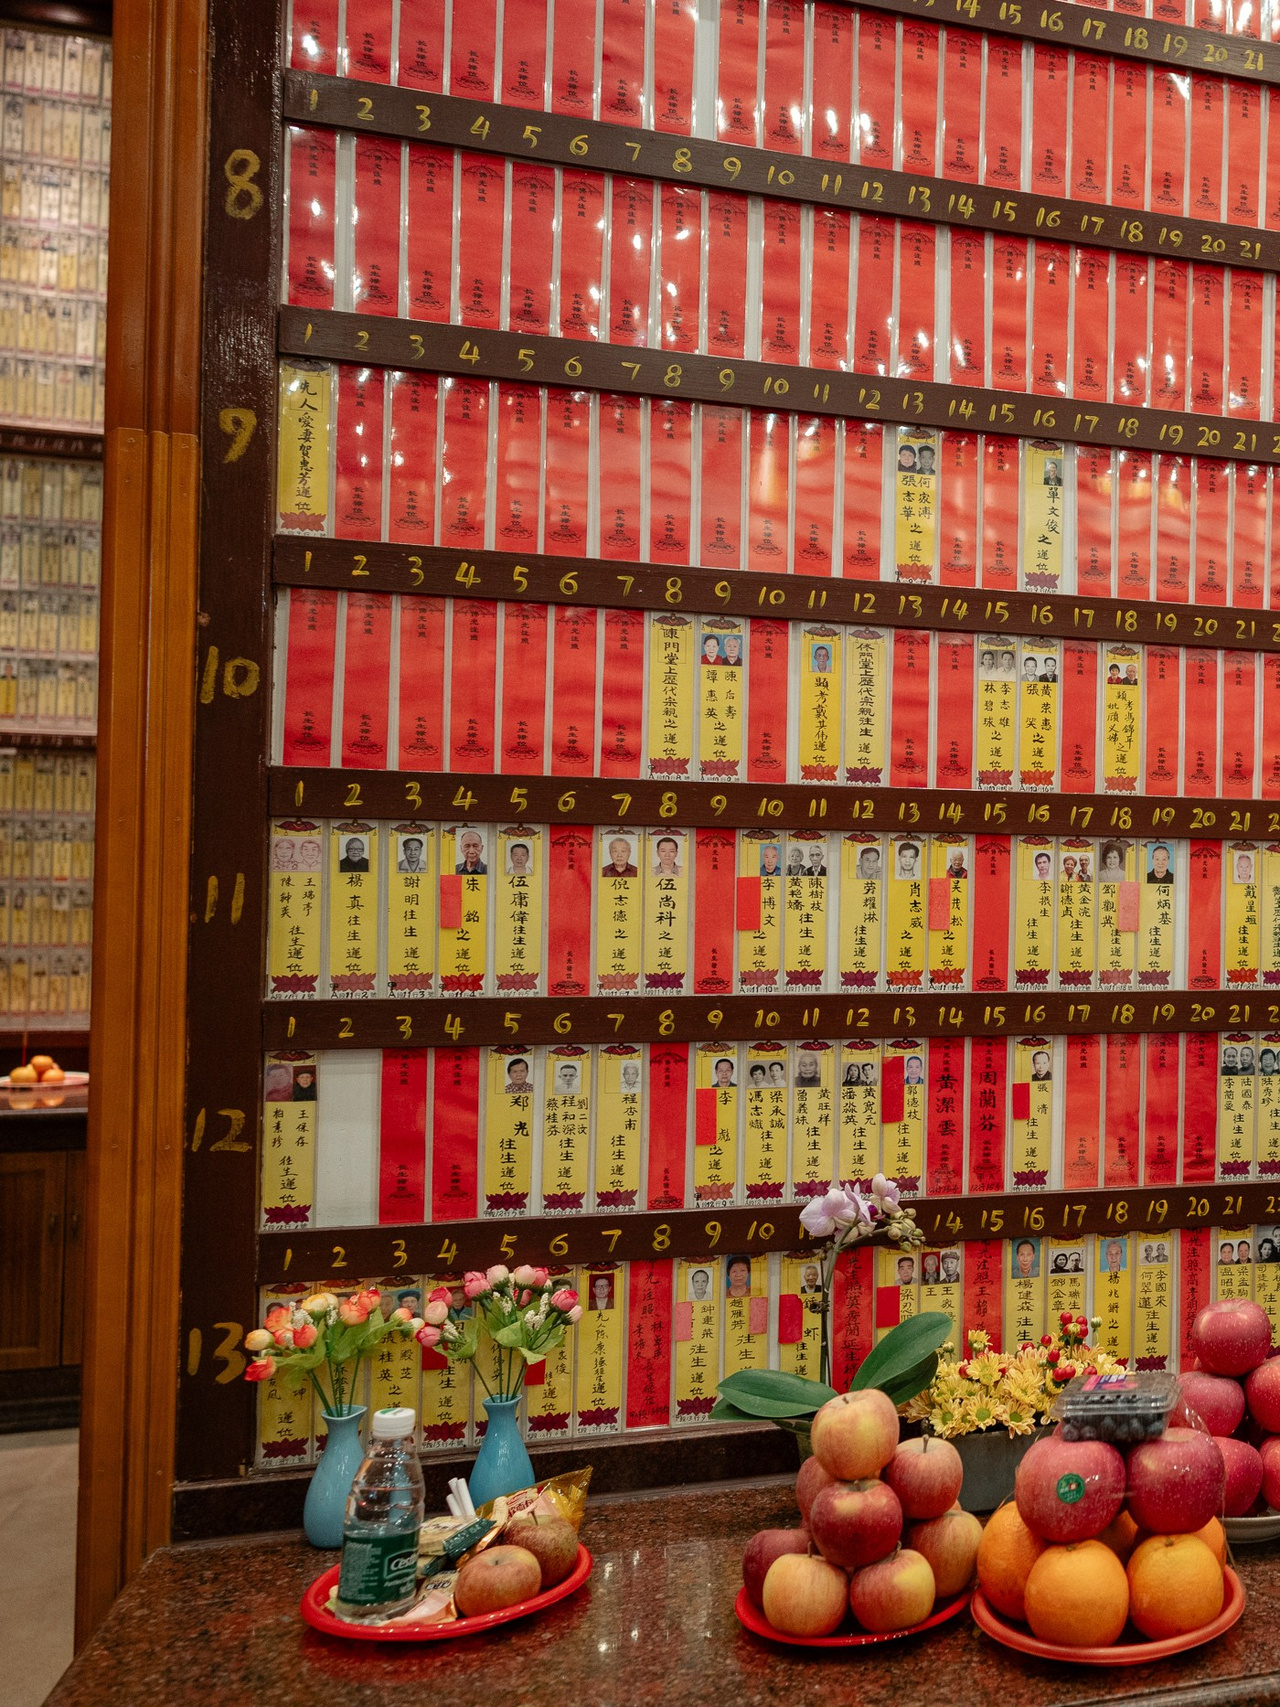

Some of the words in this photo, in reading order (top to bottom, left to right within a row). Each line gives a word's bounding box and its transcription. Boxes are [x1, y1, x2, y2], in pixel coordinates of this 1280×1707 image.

[1039, 9, 1065, 32] 16
[1081, 17, 1107, 41] 17
[1123, 25, 1150, 52] 18
[1162, 32, 1190, 57] 19
[310, 89, 318, 109] 1
[357, 97, 374, 121] 2
[415, 104, 432, 132] 3
[470, 115, 490, 139] 4
[522, 125, 543, 148] 5
[569, 134, 589, 156] 6
[625, 141, 641, 162] 7
[671, 147, 693, 173] 8
[722, 156, 742, 180] 9
[767, 165, 795, 186] 10
[225, 149, 263, 219] 8
[304, 322, 313, 343] 1
[357, 330, 370, 351] 2
[409, 334, 425, 357] 3
[458, 340, 481, 366] 4
[517, 348, 536, 371] 5
[564, 355, 583, 377] 6
[620, 361, 641, 380] 7
[663, 364, 683, 388] 8
[219, 408, 257, 463] 9
[305, 550, 313, 572] 1
[351, 554, 370, 576] 2
[408, 556, 425, 586] 3
[454, 561, 481, 588] 4
[513, 565, 529, 593] 5
[559, 571, 579, 595] 6
[616, 575, 635, 595] 7
[664, 576, 683, 604] 8
[200, 646, 260, 704] 10
[294, 779, 305, 807] 1
[343, 783, 363, 807] 2
[405, 781, 422, 810] 3
[452, 785, 478, 811] 4
[509, 787, 528, 812] 5
[557, 790, 577, 813] 6
[611, 793, 632, 817] 7
[658, 791, 678, 818] 8
[710, 794, 727, 816] 9
[757, 797, 784, 817] 10
[1228, 810, 1251, 832] 21
[205, 872, 246, 924] 11
[287, 1016, 296, 1037] 1
[338, 1015, 355, 1040] 2
[396, 1015, 413, 1039] 3
[444, 1013, 465, 1041] 4
[504, 1011, 521, 1034] 5
[553, 1012, 572, 1034] 6
[607, 1013, 625, 1032] 7
[658, 1009, 675, 1036] 8
[192, 1107, 252, 1152] 12
[284, 1248, 292, 1271] 1
[331, 1246, 347, 1268] 2
[392, 1239, 408, 1268] 3
[437, 1238, 457, 1262] 4
[499, 1233, 518, 1258] 5
[549, 1233, 569, 1257] 6
[601, 1229, 622, 1252] 7
[652, 1223, 671, 1252] 8
[705, 1221, 722, 1247] 9
[747, 1220, 775, 1240] 10
[981, 1209, 1004, 1232] 15
[1023, 1206, 1045, 1231] 16
[1063, 1204, 1087, 1227] 17
[1106, 1200, 1129, 1224] 18
[187, 1321, 247, 1385] 13
